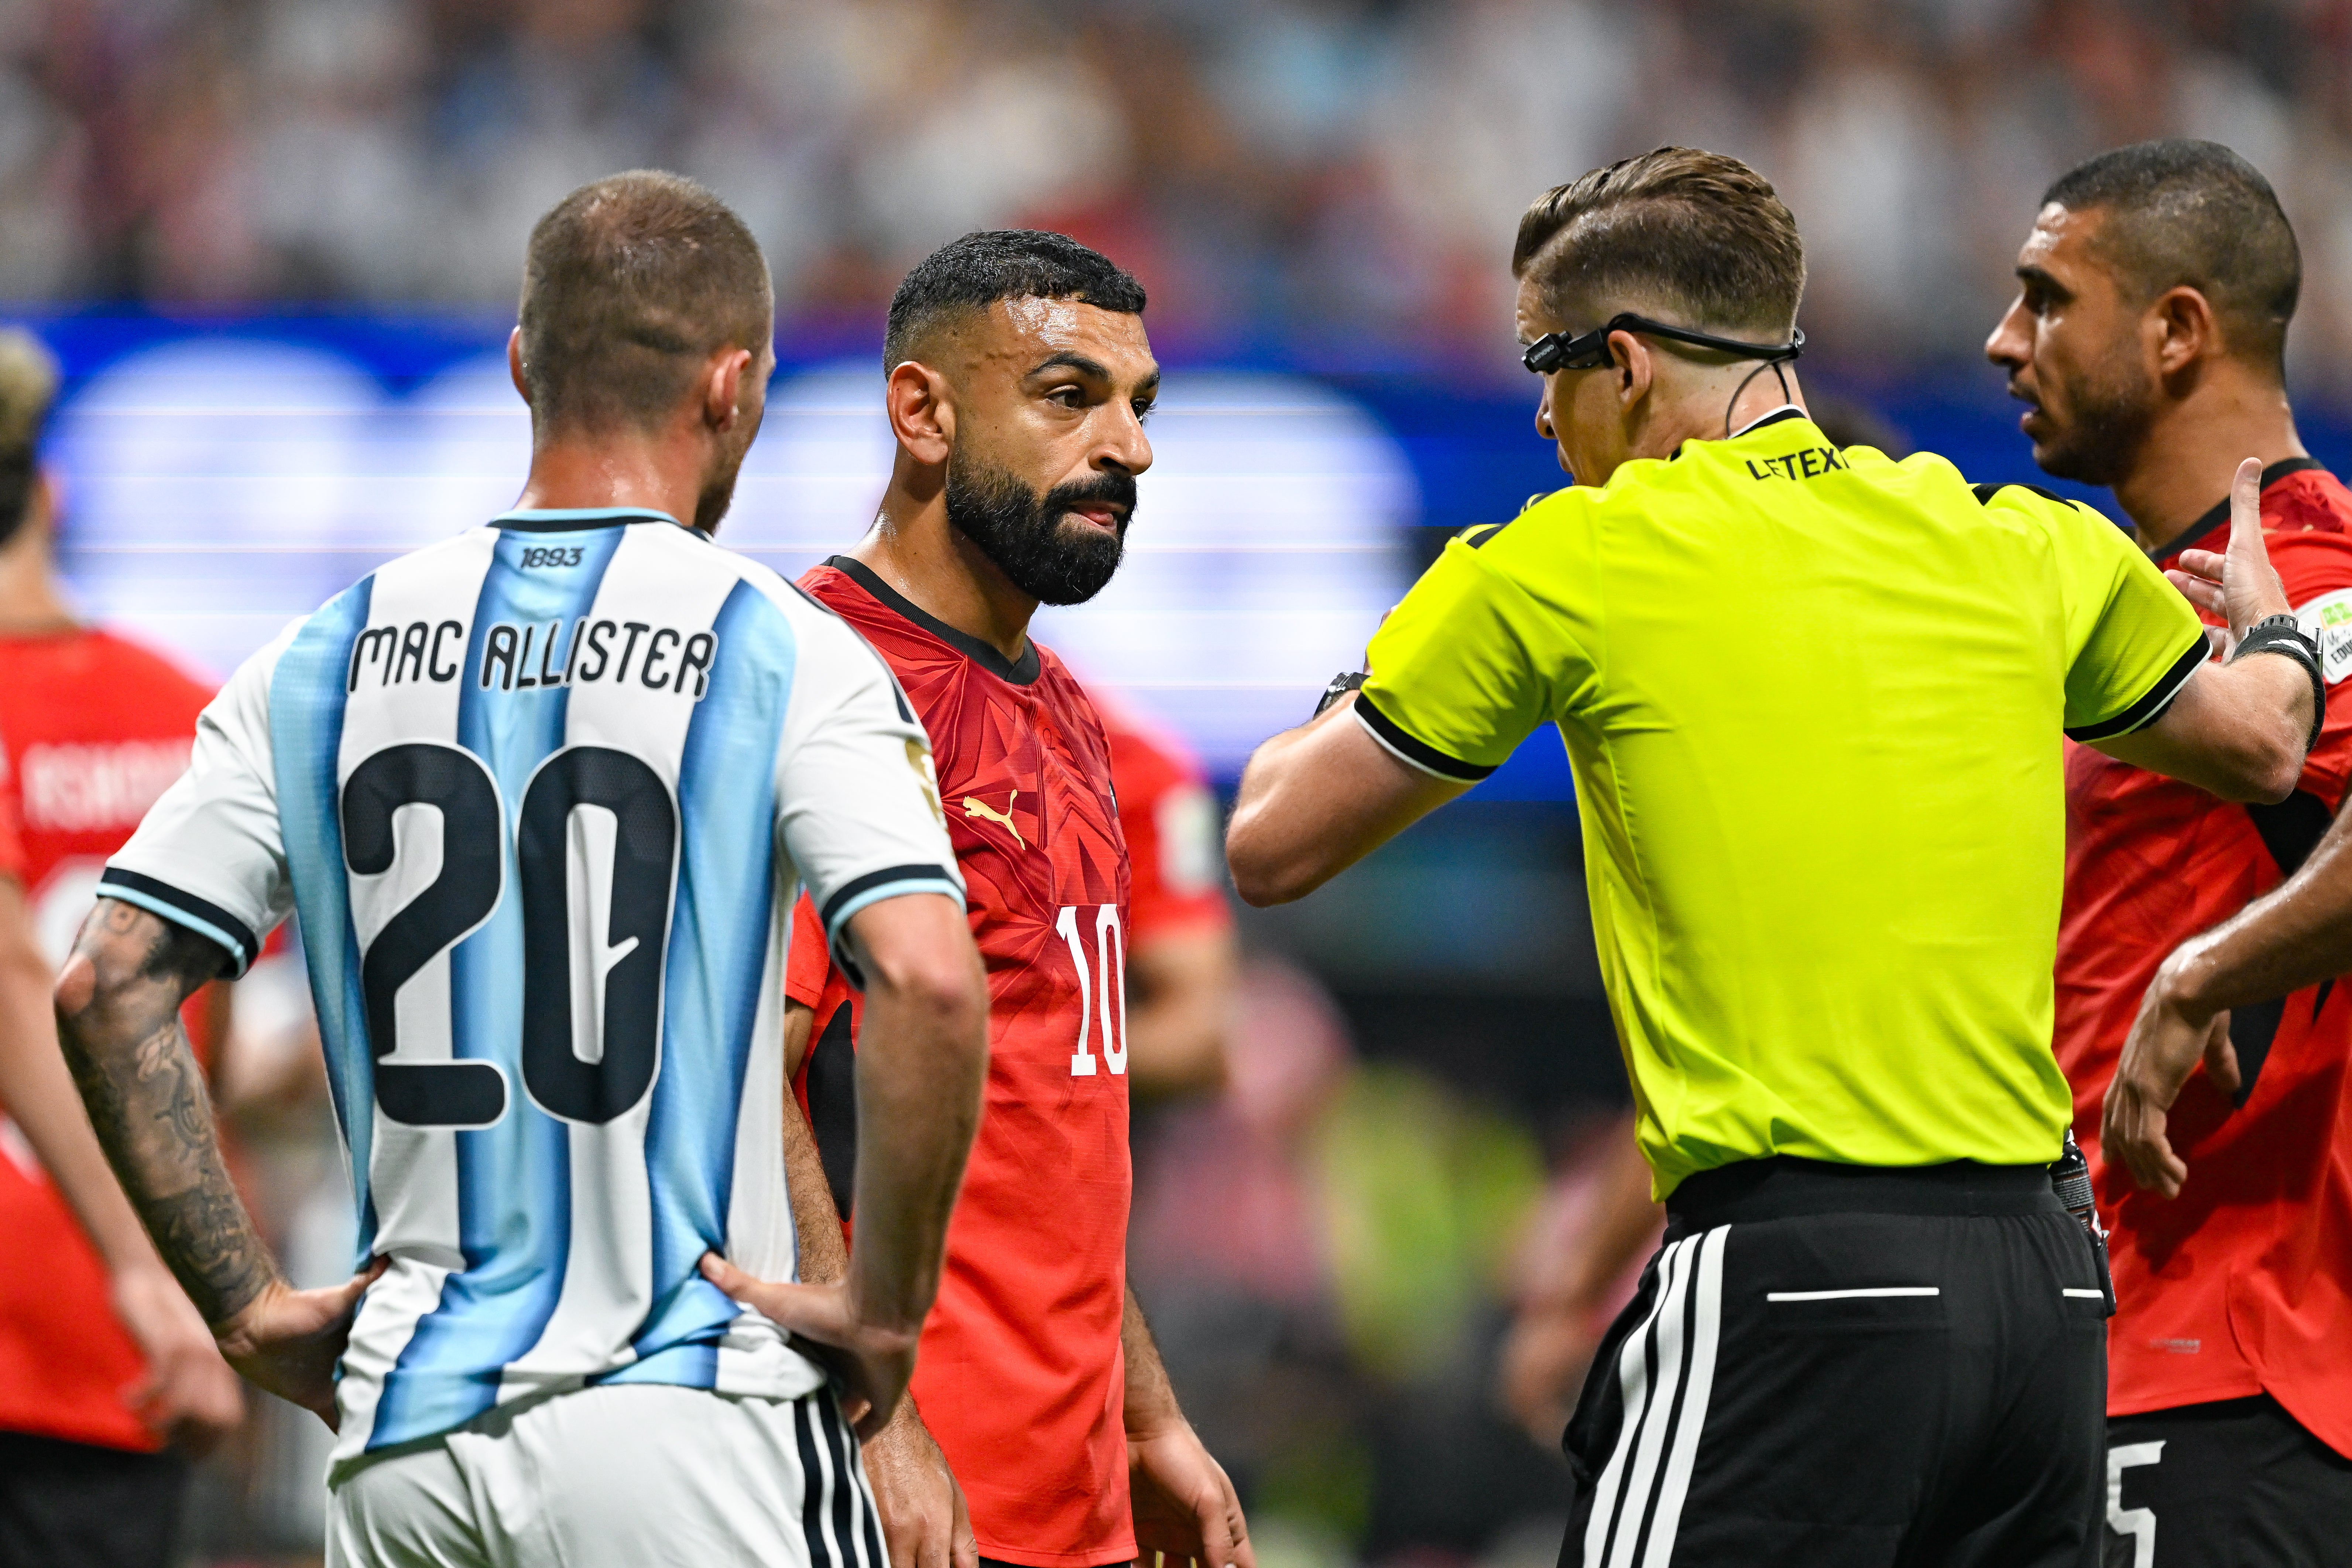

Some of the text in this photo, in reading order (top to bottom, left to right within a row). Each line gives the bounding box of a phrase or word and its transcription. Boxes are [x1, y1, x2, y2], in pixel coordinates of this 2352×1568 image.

[521, 548, 584, 569] 1893
[348, 619, 715, 698] MAC ALLISTER
[2331, 639, 2352, 664] EDU
[339, 742, 680, 1128] 20
[1055, 903, 1128, 1076] 10
[2106, 1440, 2167, 1568] 5
